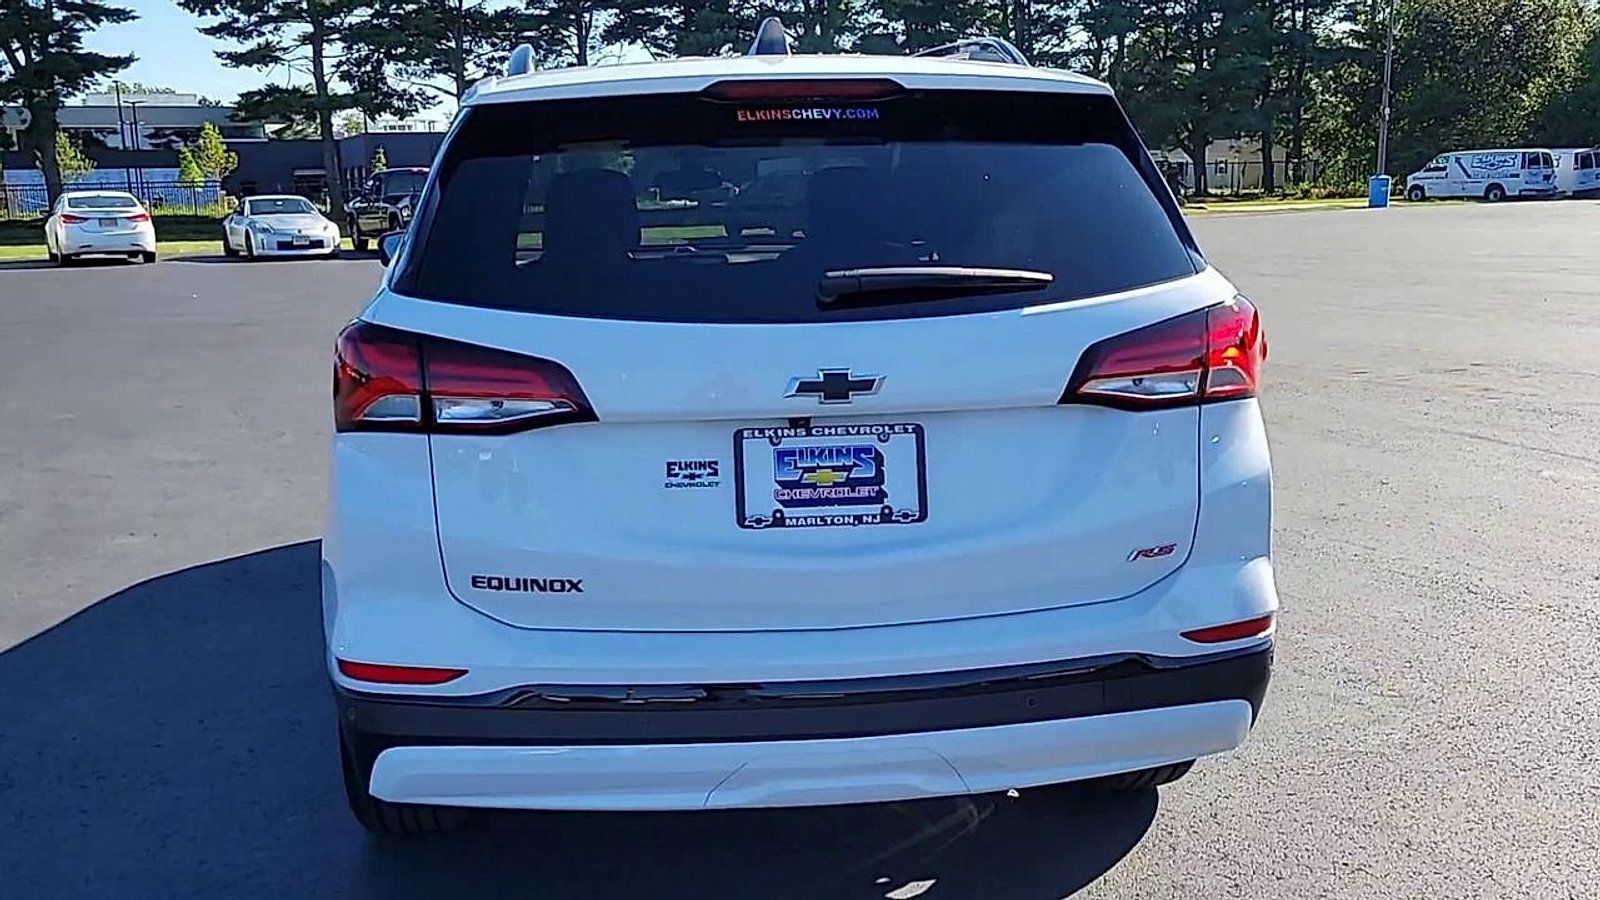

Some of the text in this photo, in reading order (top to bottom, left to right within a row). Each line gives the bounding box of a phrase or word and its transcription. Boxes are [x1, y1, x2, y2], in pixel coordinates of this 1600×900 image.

[737, 108, 880, 121] ELKINSCHEVY.COM
[743, 424, 916, 438] ELKINS CHEVROLET
[666, 460, 719, 479] ELKINS
[774, 446, 877, 480] ELKINS
[665, 481, 721, 489] CHEVROLET
[774, 486, 880, 501] CHEVROLET
[785, 514, 882, 527] MARLTON, NJ
[1131, 543, 1177, 562] RS
[471, 575, 584, 593] EQUINOX
